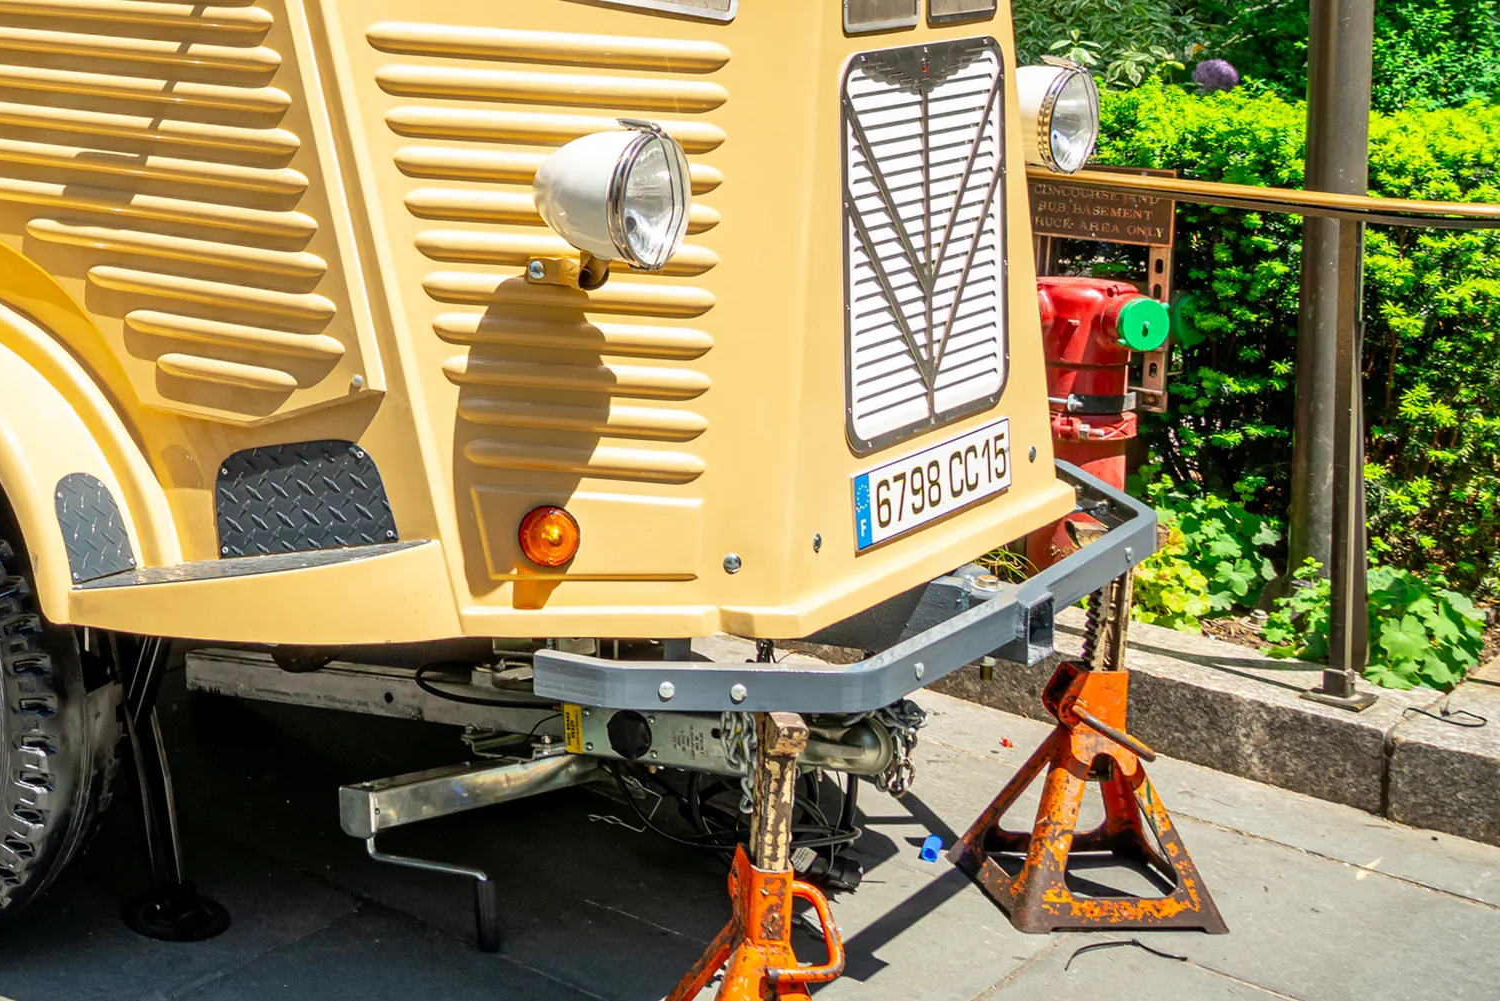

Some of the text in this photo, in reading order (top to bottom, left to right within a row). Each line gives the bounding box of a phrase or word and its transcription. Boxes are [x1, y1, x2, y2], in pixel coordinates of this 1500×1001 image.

[1034, 184, 1160, 205] CONCOURSE AND
[1038, 200, 1154, 222] SUB BASEMENT
[1031, 215, 1165, 239] RUCK AREA ONLY
[875, 459, 942, 530] 6798
[860, 518, 867, 537] F
